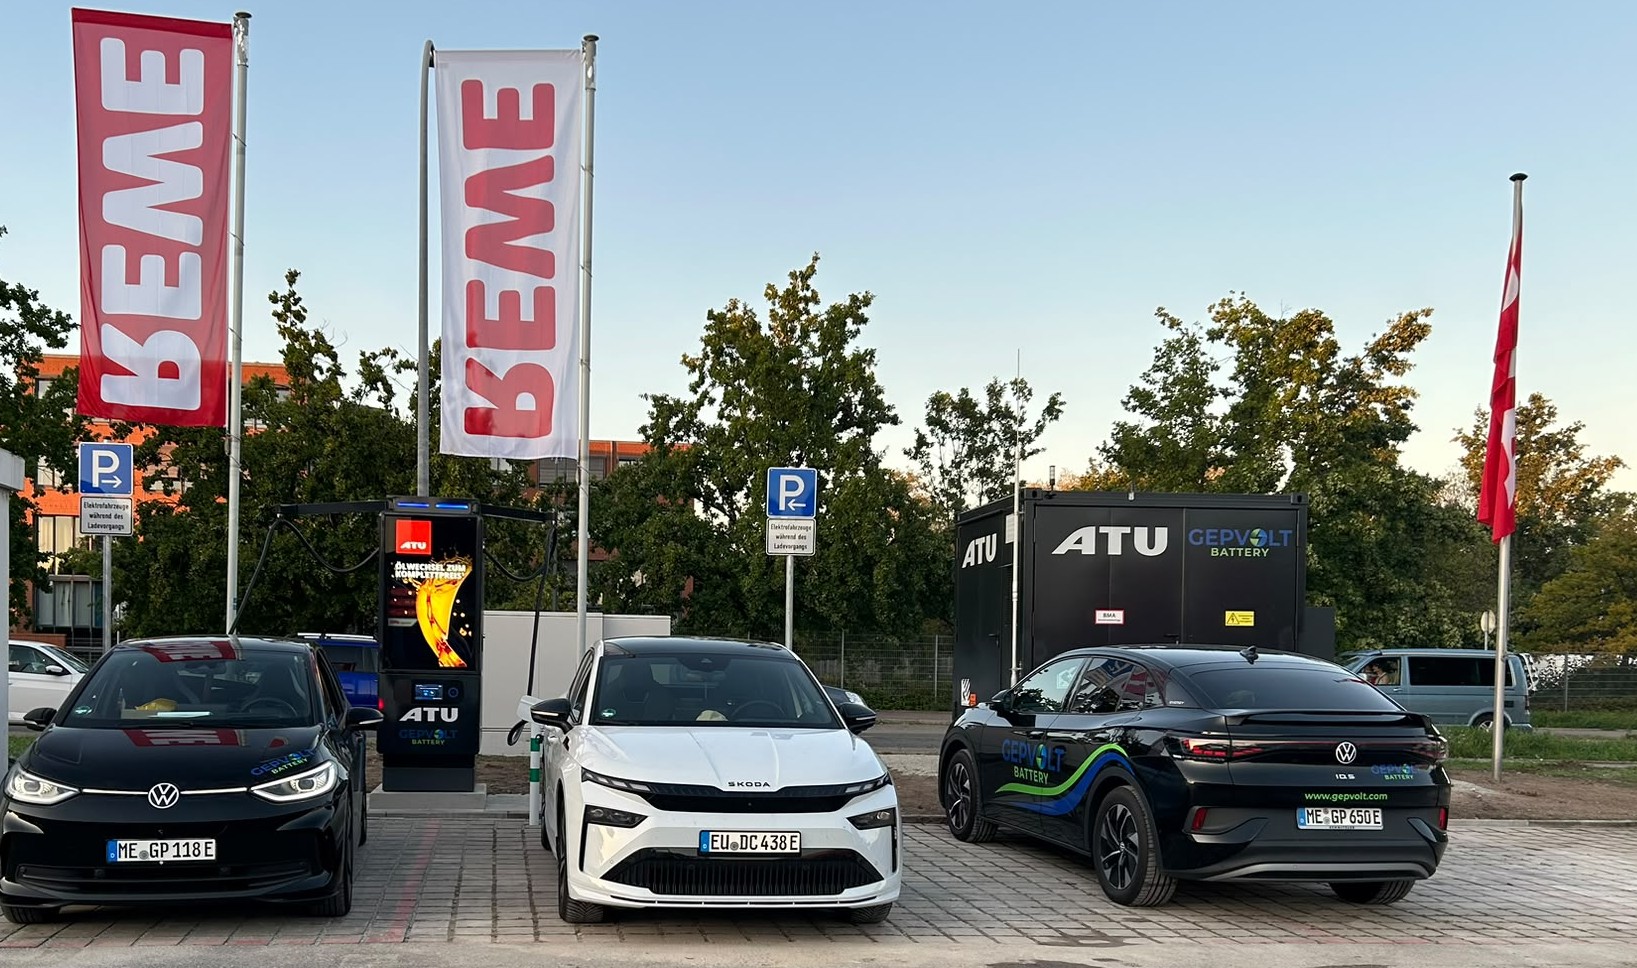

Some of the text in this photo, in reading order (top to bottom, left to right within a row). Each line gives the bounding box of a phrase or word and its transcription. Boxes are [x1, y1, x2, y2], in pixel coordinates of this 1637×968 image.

[92, 450, 120, 488] P
[779, 475, 805, 511] P
[84, 502, 129, 511] Elektrofahrzeuge
[89, 511, 124, 520] während des
[87, 522, 125, 531] Ladevorgangs
[771, 523, 812, 532] Elektrofahrzeuge
[1051, 525, 1169, 556] ATU
[1188, 528, 1293, 547] GEPVOLT
[400, 541, 427, 550] ATU
[773, 543, 808, 551] Ladevorgangs
[961, 533, 997, 569] ATU
[1211, 547, 1270, 557] BATTERY
[394, 561, 466, 573] ÖLWECHSEL ZUM
[399, 707, 458, 722] ATU
[399, 728, 459, 739] GEPVOLT
[1002, 739, 1066, 772] GEPVOLT
[270, 758, 308, 774] BATTERY
[1013, 766, 1048, 785] BATTERY
[1305, 791, 1388, 801] www.gepvolt.com
[1306, 809, 1324, 824] ME
[1331, 810, 1347, 824] GP
[711, 834, 730, 851] EU
[740, 834, 758, 851] DC
[118, 842, 138, 859] ME
[149, 842, 169, 858] GP
